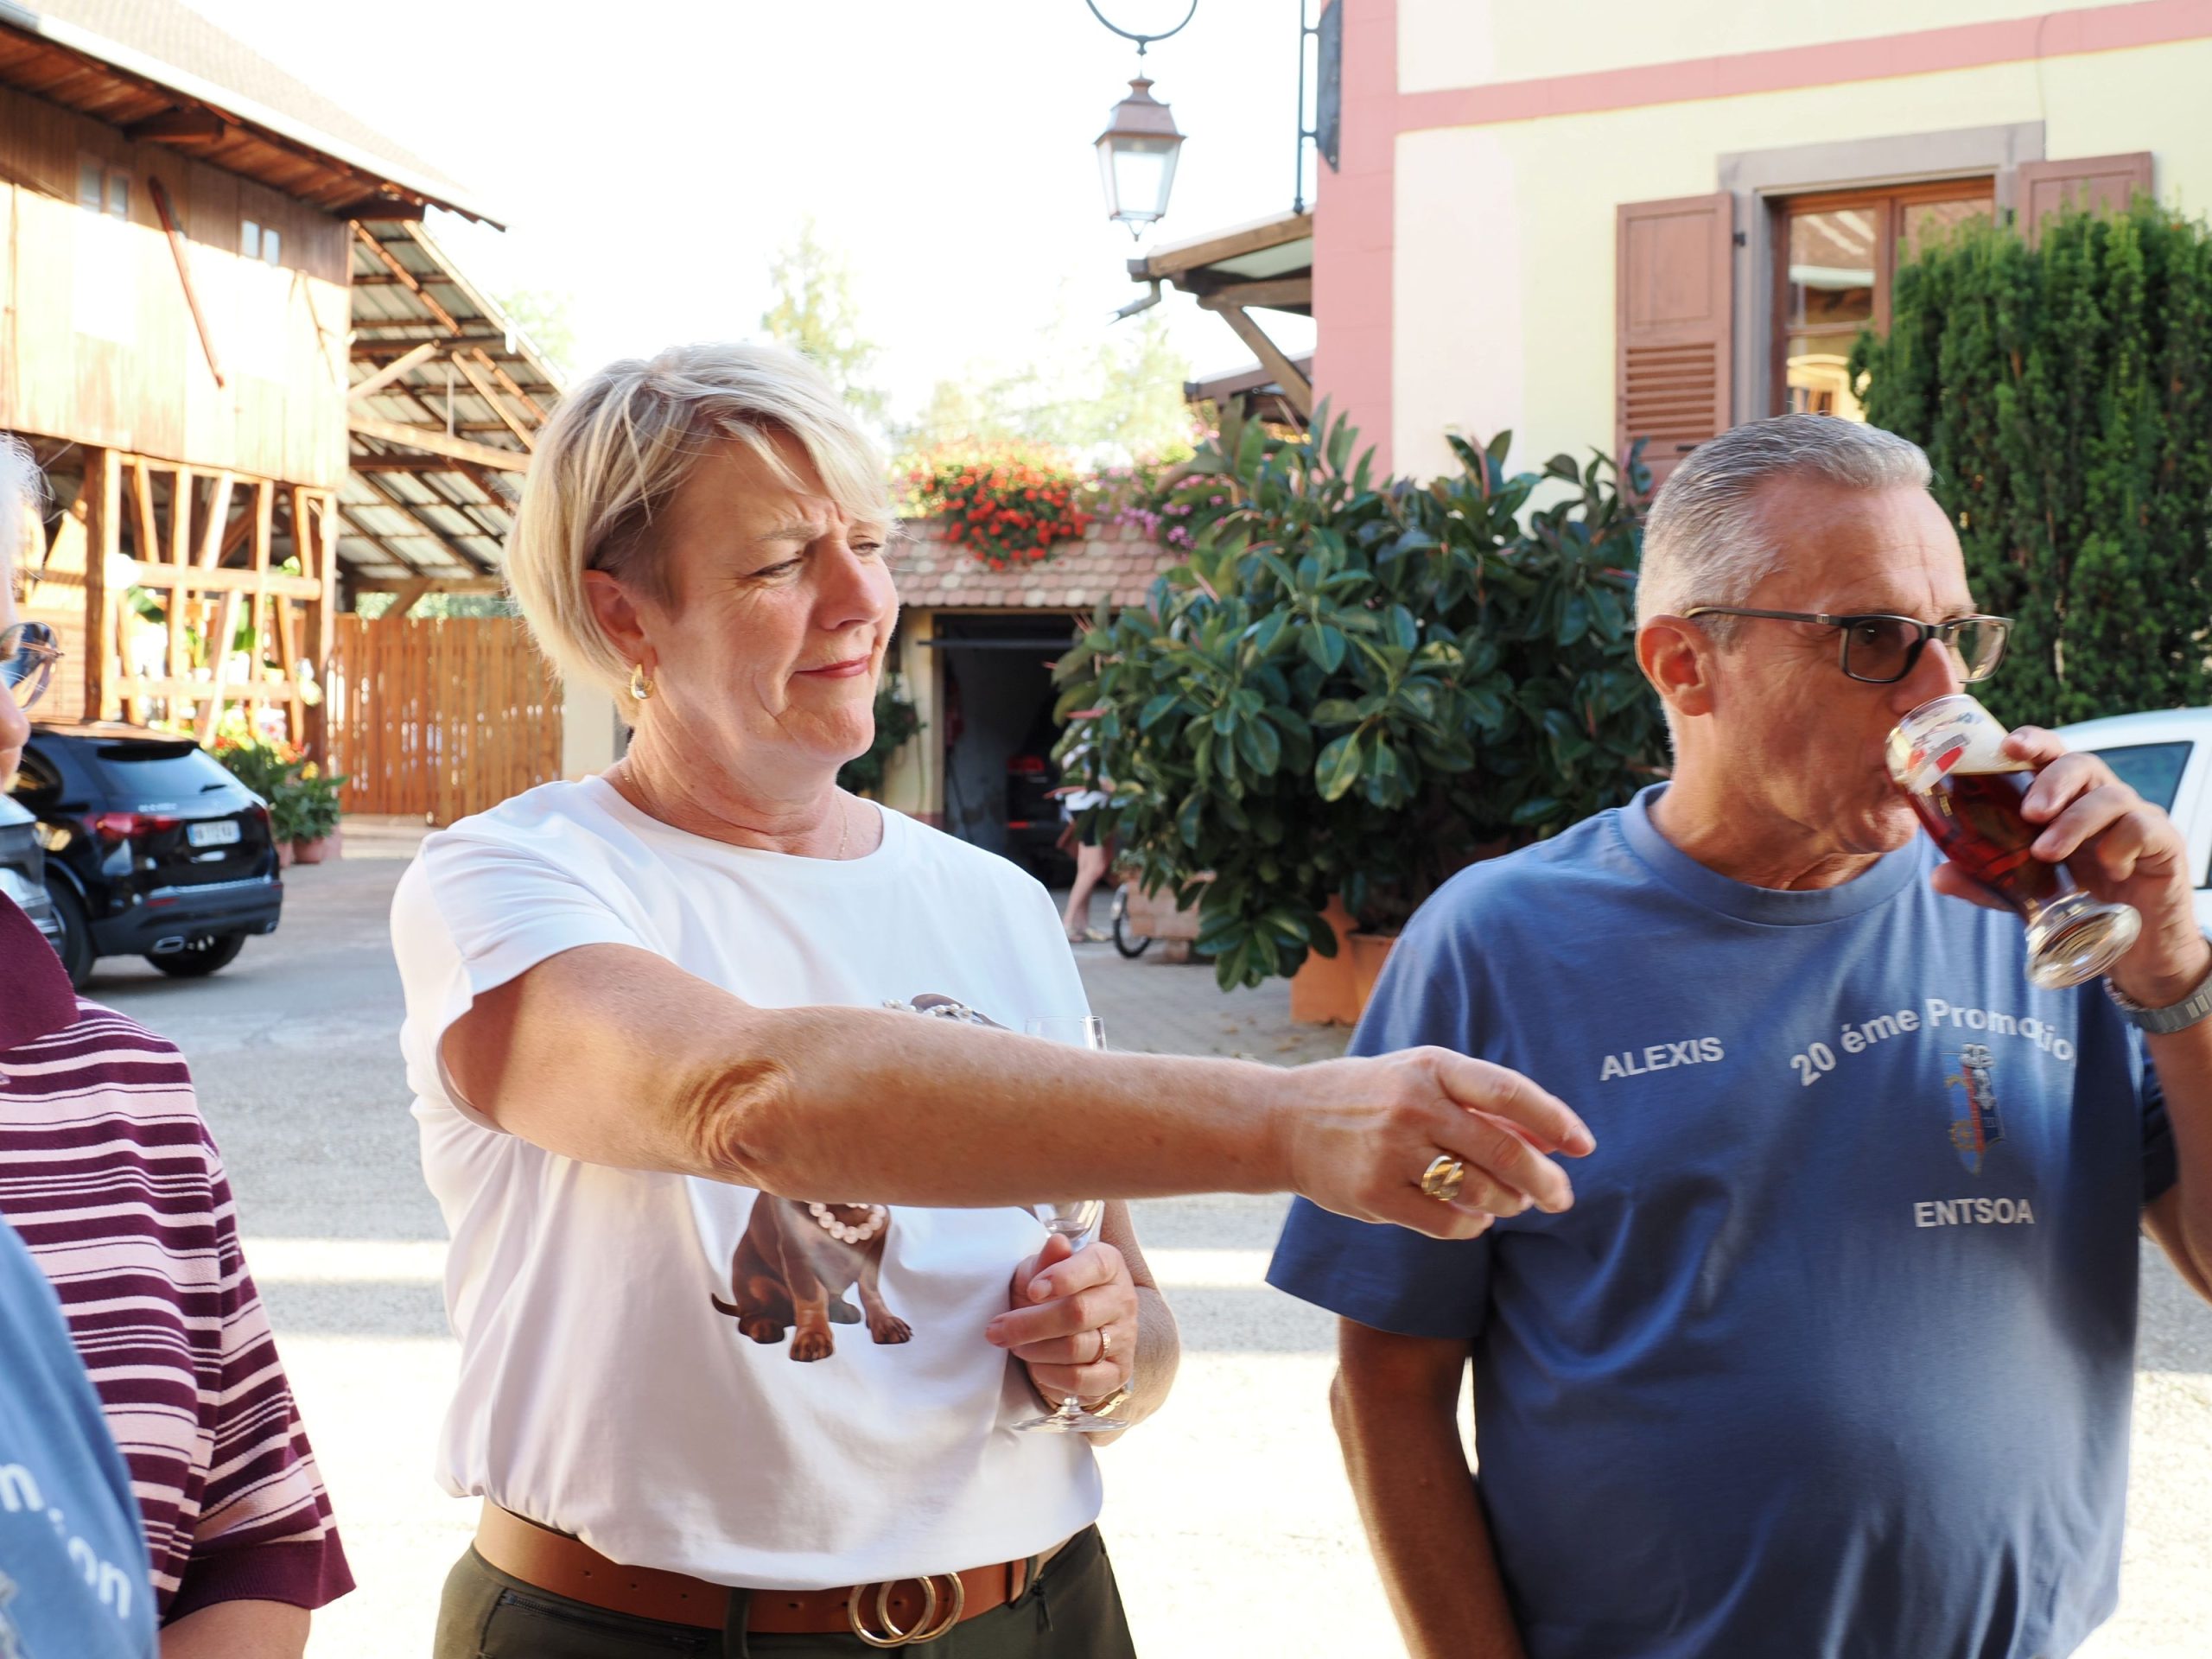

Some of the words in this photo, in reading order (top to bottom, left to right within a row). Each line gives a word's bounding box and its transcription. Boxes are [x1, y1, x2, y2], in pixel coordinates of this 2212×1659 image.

[1599, 1037, 1725, 1081] ALEXIS
[1789, 1041, 1836, 1087] 20
[1913, 1198, 2036, 1228] ENTSOA
